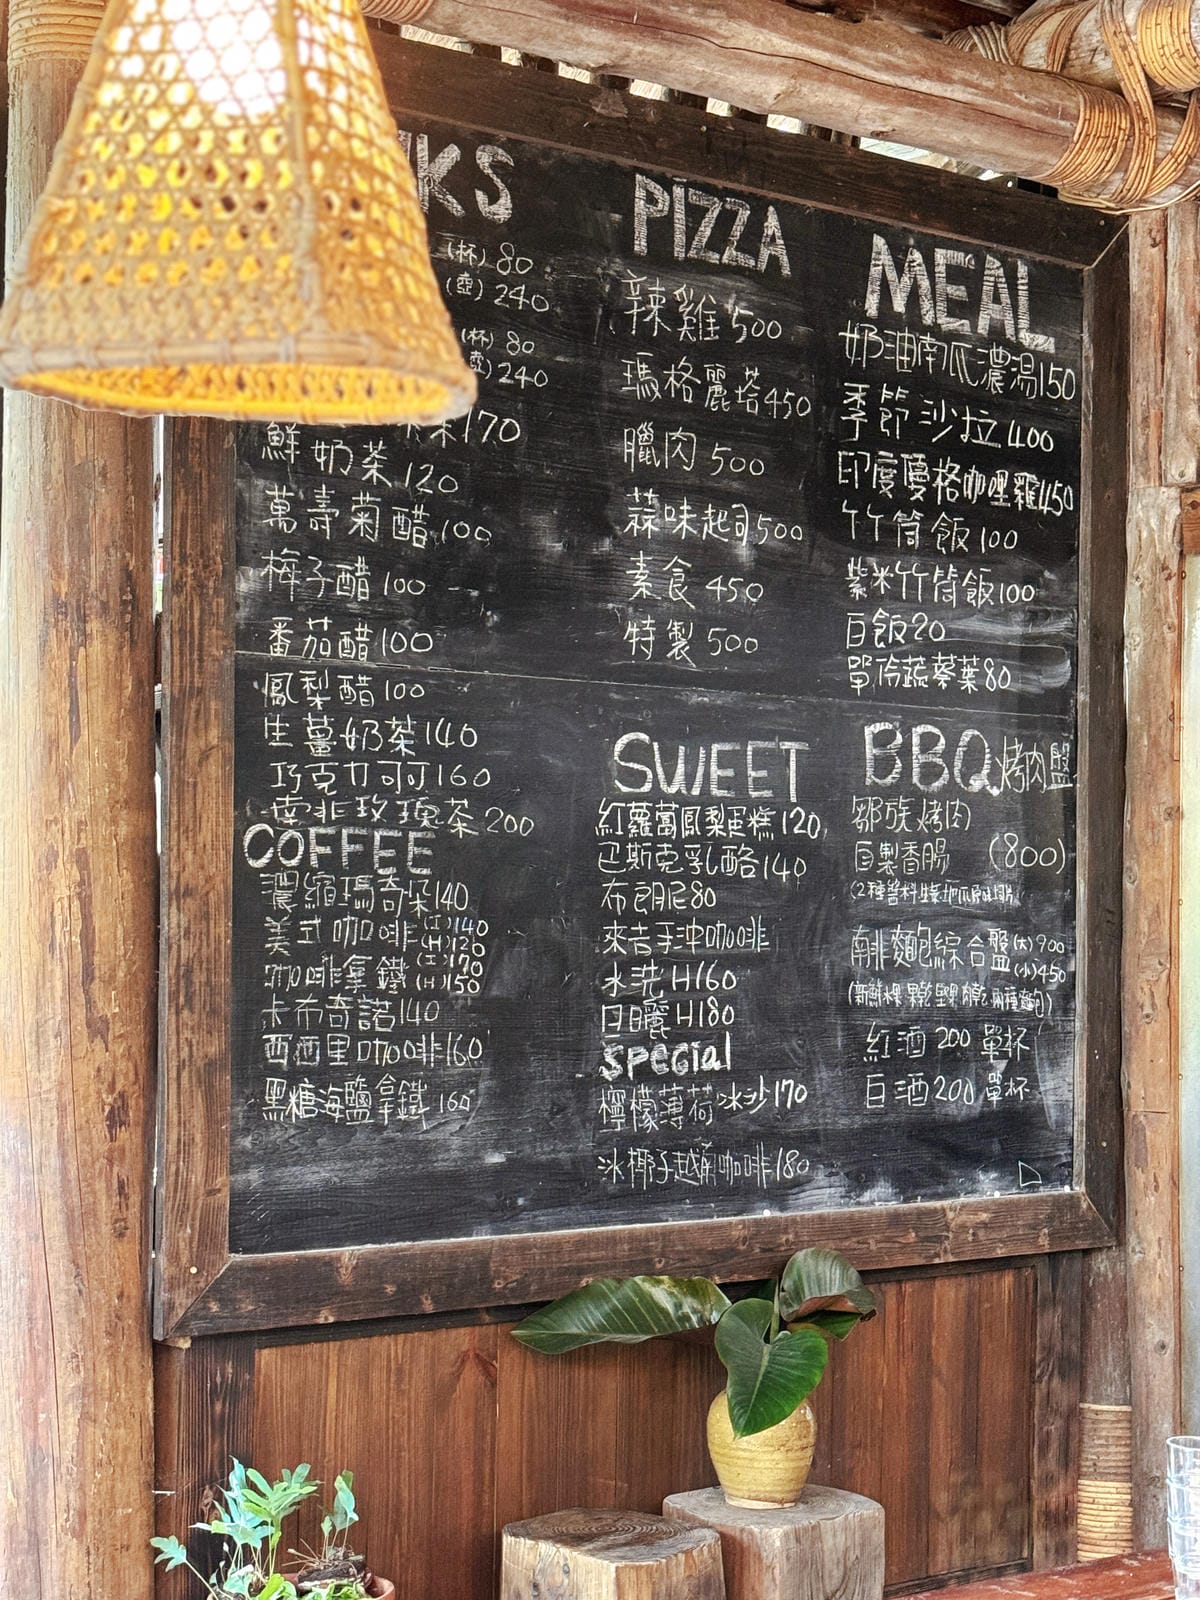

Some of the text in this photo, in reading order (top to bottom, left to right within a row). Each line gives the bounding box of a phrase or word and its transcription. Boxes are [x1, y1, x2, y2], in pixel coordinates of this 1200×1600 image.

[398, 130, 514, 223] KS
[634, 173, 791, 278] PIZZA
[496, 243, 533, 275] 80
[494, 284, 549, 312] 240
[621, 269, 782, 344] 辣雞 500
[864, 233, 1056, 354] MEAL
[506, 331, 534, 356] 80
[838, 320, 1076, 401] 奶油南瓜濃湯 150
[498, 362, 548, 389] 240
[621, 352, 812, 420] 瑪格麗塔 450
[465, 407, 521, 443] 170
[840, 382, 1054, 452] 季節沙拉 400
[261, 422, 392, 487] 鮮奶茶
[404, 462, 459, 494] 120
[710, 442, 765, 476] 500
[262, 484, 492, 549] 萬壽菊醋 100
[623, 487, 803, 545] 蒜味起司 500
[841, 499, 1018, 554] 竹筒飯 100
[261, 547, 426, 601] 梅子醋 100
[625, 550, 764, 610] 素食 450
[845, 556, 1036, 609] 紫米竹筒飯 100
[270, 616, 433, 662] 番茄醋 100
[623, 614, 759, 668] 特製 500
[846, 607, 946, 649] 白飯 20
[264, 667, 425, 710] 鳳梨醋 100
[984, 658, 1011, 692] 80
[264, 712, 478, 757] 生薑奶茶 140
[270, 760, 491, 795] 巧克力可可 160
[613, 731, 810, 803] SWEET
[864, 721, 1000, 797] BBQ
[270, 794, 535, 839] 南非玫瑰茶 200
[782, 806, 821, 839] 120
[851, 795, 971, 834] 鄒族烤肉
[243, 823, 437, 875] COFFEE
[598, 841, 807, 882] 巴斯克乳酪 140
[854, 832, 1066, 876] 自製香腸 (800)
[435, 880, 469, 911] 140
[691, 880, 716, 909] 80
[264, 914, 418, 957] 美式咖啡
[264, 954, 410, 994] 咖啡拿鐵
[601, 958, 664, 998] 水洗
[261, 993, 440, 1033] 卡布奇諾 140
[601, 999, 671, 1039] 日曬
[262, 1031, 482, 1071] 西西里咖啡 160
[863, 1021, 1030, 1063] 紅酒 200 單杯
[262, 1072, 471, 1131] 黑糖海鹽拿鐵 160
[775, 1079, 808, 1109] 170
[866, 1071, 1030, 1108] 白酒 200 單杯
[777, 1147, 809, 1182] 180
